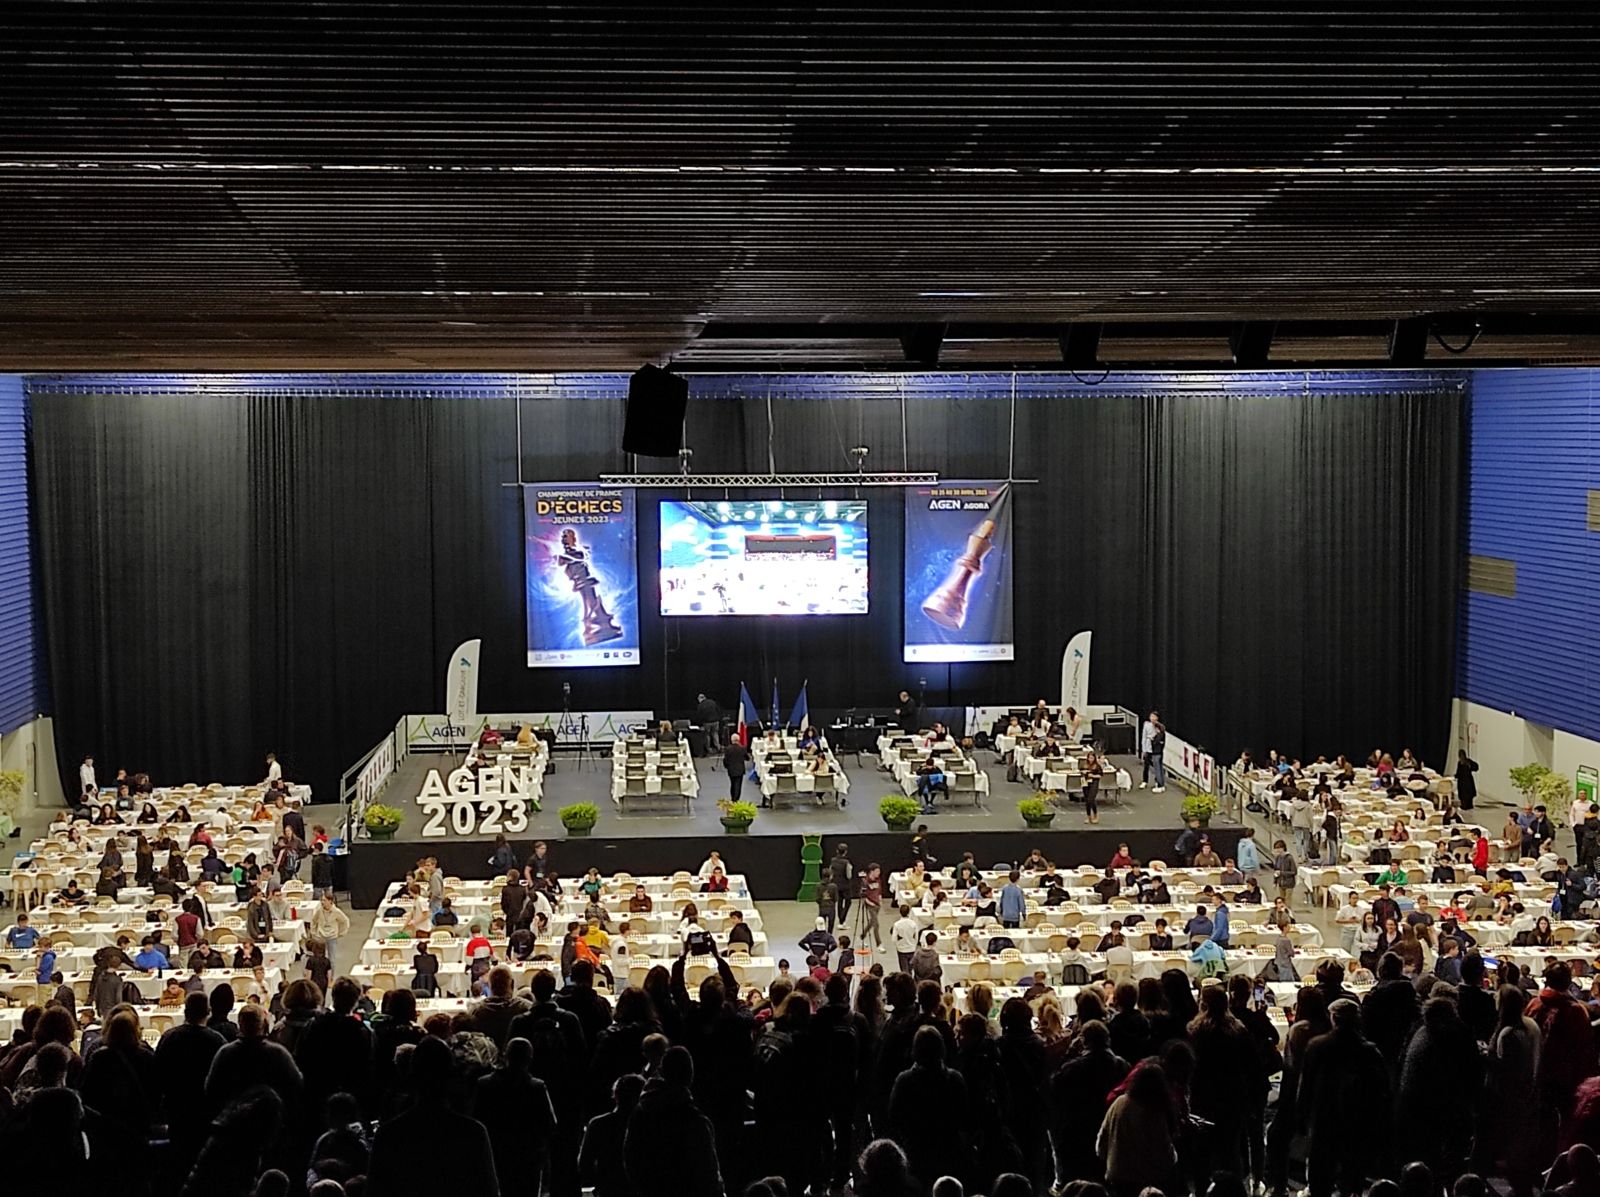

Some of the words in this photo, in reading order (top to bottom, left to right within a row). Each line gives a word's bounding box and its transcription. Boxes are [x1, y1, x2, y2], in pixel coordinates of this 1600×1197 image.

[538, 490, 584, 498] CHAMPIONNAT
[929, 499, 961, 509] AGEN
[552, 516, 585, 524] JEUNES
[587, 515, 609, 523] 2023
[432, 726, 465, 737] AGEN
[419, 767, 529, 800] AGEN
[422, 800, 528, 836] 2023
